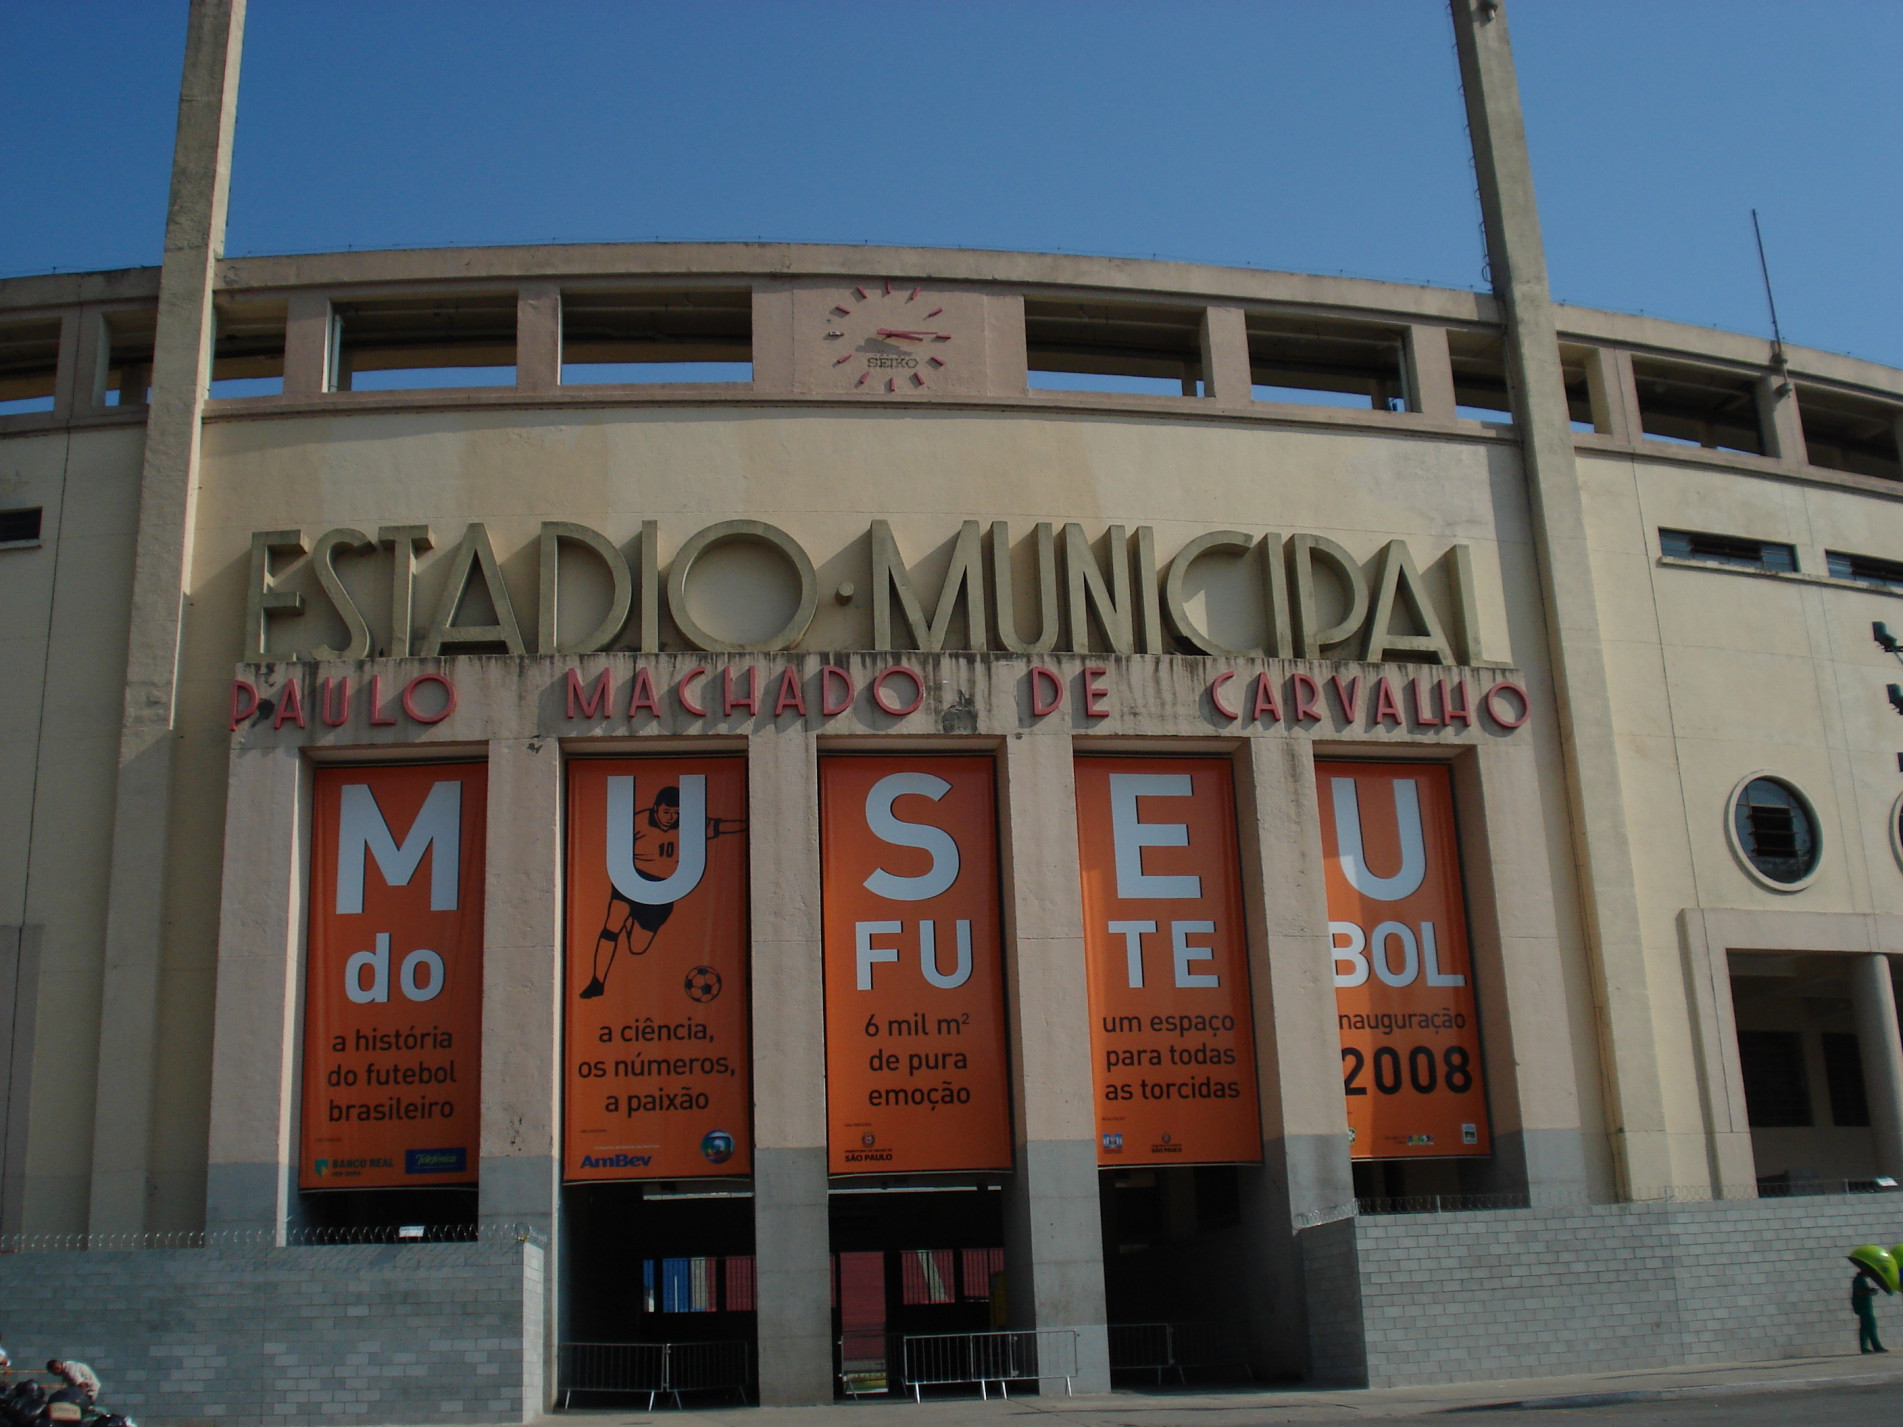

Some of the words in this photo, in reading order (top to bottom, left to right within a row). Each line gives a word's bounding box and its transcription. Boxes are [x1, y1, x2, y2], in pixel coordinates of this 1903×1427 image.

[867, 356, 919, 369] SEIKO
[244, 519, 819, 662] ESTADIO
[870, 518, 1515, 670] MUNICIPAL
[228, 672, 457, 731] PAULO
[566, 665, 924, 719] MACHADO
[1031, 666, 1110, 718] DE
[1211, 670, 1532, 729] CARVALHO
[659, 841, 674, 858] 10
[344, 932, 446, 1004] do
[855, 919, 972, 991] FU
[1107, 920, 1221, 988] TE
[1328, 920, 1466, 988] BOL
[598, 1026, 613, 1044] a
[620, 1017, 714, 1044] ciência,
[864, 1013, 880, 1038] 6
[887, 1013, 929, 1037] mil
[1102, 1016, 1142, 1034] um
[1149, 1015, 1236, 1041] espaço
[1338, 1007, 1467, 1035] nauguração
[331, 1035, 347, 1053] a
[354, 1025, 453, 1053] história
[577, 1060, 607, 1079] os
[614, 1052, 736, 1078] números,
[869, 1048, 900, 1072] de
[908, 1052, 968, 1077] pura
[1106, 1049, 1162, 1073] para
[1168, 1042, 1237, 1067] todas
[1341, 1045, 1474, 1097] 2008
[327, 1063, 358, 1088] do
[365, 1059, 457, 1087] futebol
[604, 1095, 619, 1113] a
[626, 1086, 710, 1119] paixão
[868, 1080, 971, 1112] emoção
[1105, 1082, 1134, 1102] as
[1139, 1076, 1241, 1101] torcidas
[328, 1096, 455, 1123] brasileiro
[332, 1158, 367, 1169] BANCO
[369, 1157, 395, 1168] REAL
[580, 1154, 652, 1169] AmBev
[844, 1154, 863, 1162] SÃO
[864, 1153, 893, 1161] PAULO
